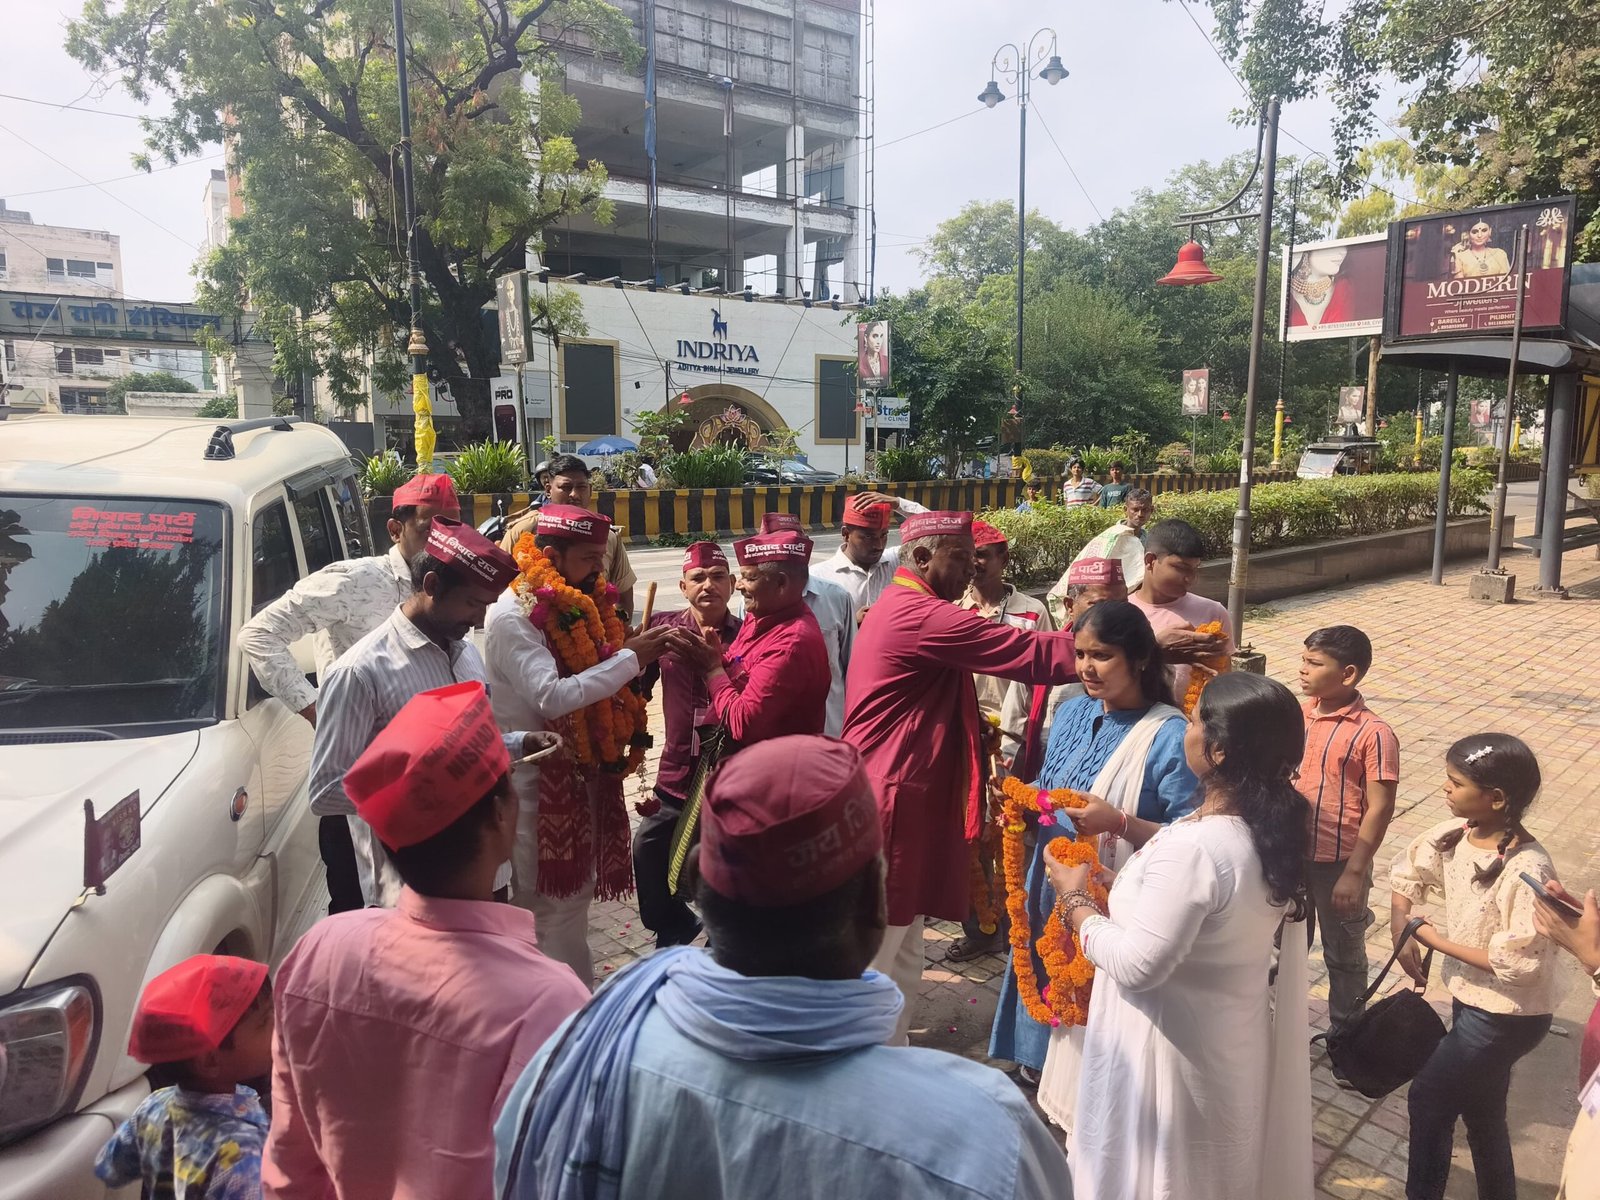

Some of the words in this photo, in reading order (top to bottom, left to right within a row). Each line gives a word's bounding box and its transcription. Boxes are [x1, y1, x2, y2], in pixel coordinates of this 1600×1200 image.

[1427, 273, 1533, 299] MODERN
[677, 340, 759, 362] INDRIYA
[678, 362, 701, 372] ADITYA
[727, 366, 759, 375] JEWELLERY
[495, 389, 513, 400] PRO
[149, 512, 197, 526] पार्टी
[565, 519, 593, 531] पार्टी
[941, 516, 962, 525] राज
[431, 528, 448, 543] जय
[446, 536, 478, 561] निषाद
[477, 557, 499, 576] राज
[745, 543, 780, 554] निषाद
[783, 542, 806, 552] पार्टी
[1079, 562, 1104, 574] पार्टी
[446, 723, 495, 778] NISHAD
[784, 822, 841, 868] जय
